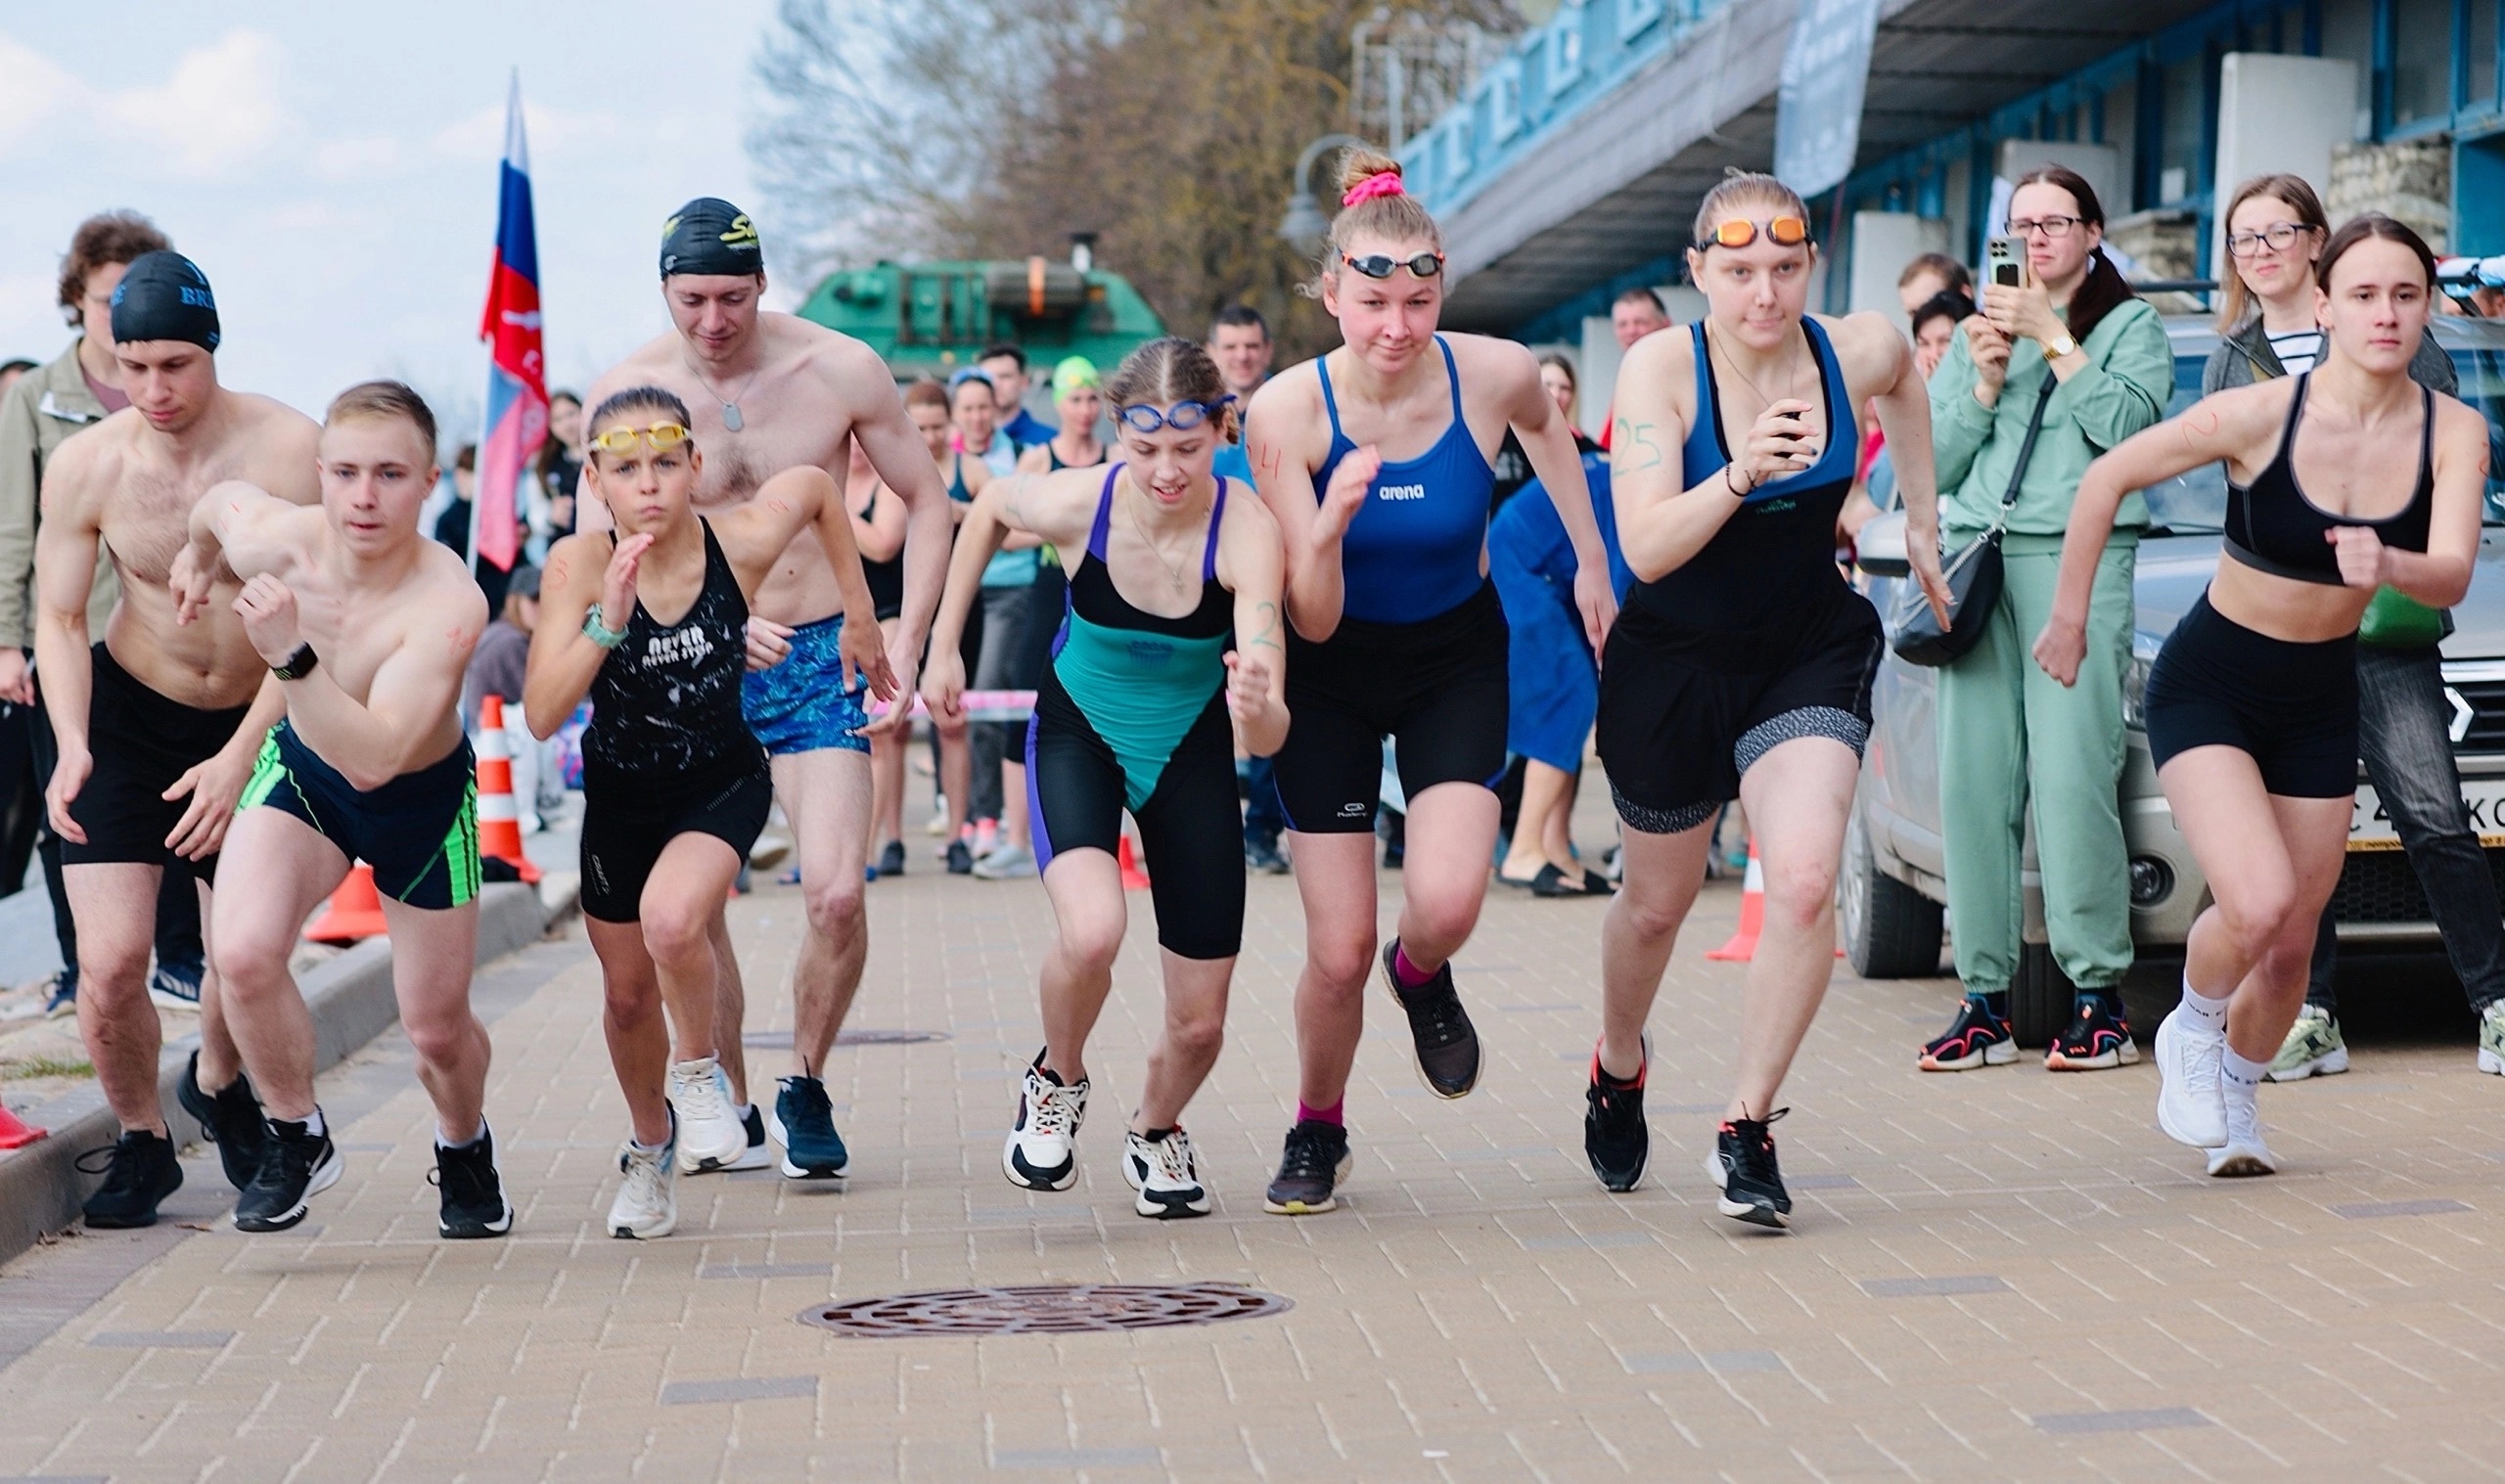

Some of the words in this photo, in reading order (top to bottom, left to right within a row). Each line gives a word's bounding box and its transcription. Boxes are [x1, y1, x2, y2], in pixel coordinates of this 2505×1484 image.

[1613, 418, 1662, 477] 25
[1379, 483, 1425, 501] arena
[648, 625, 706, 656] NEVER
